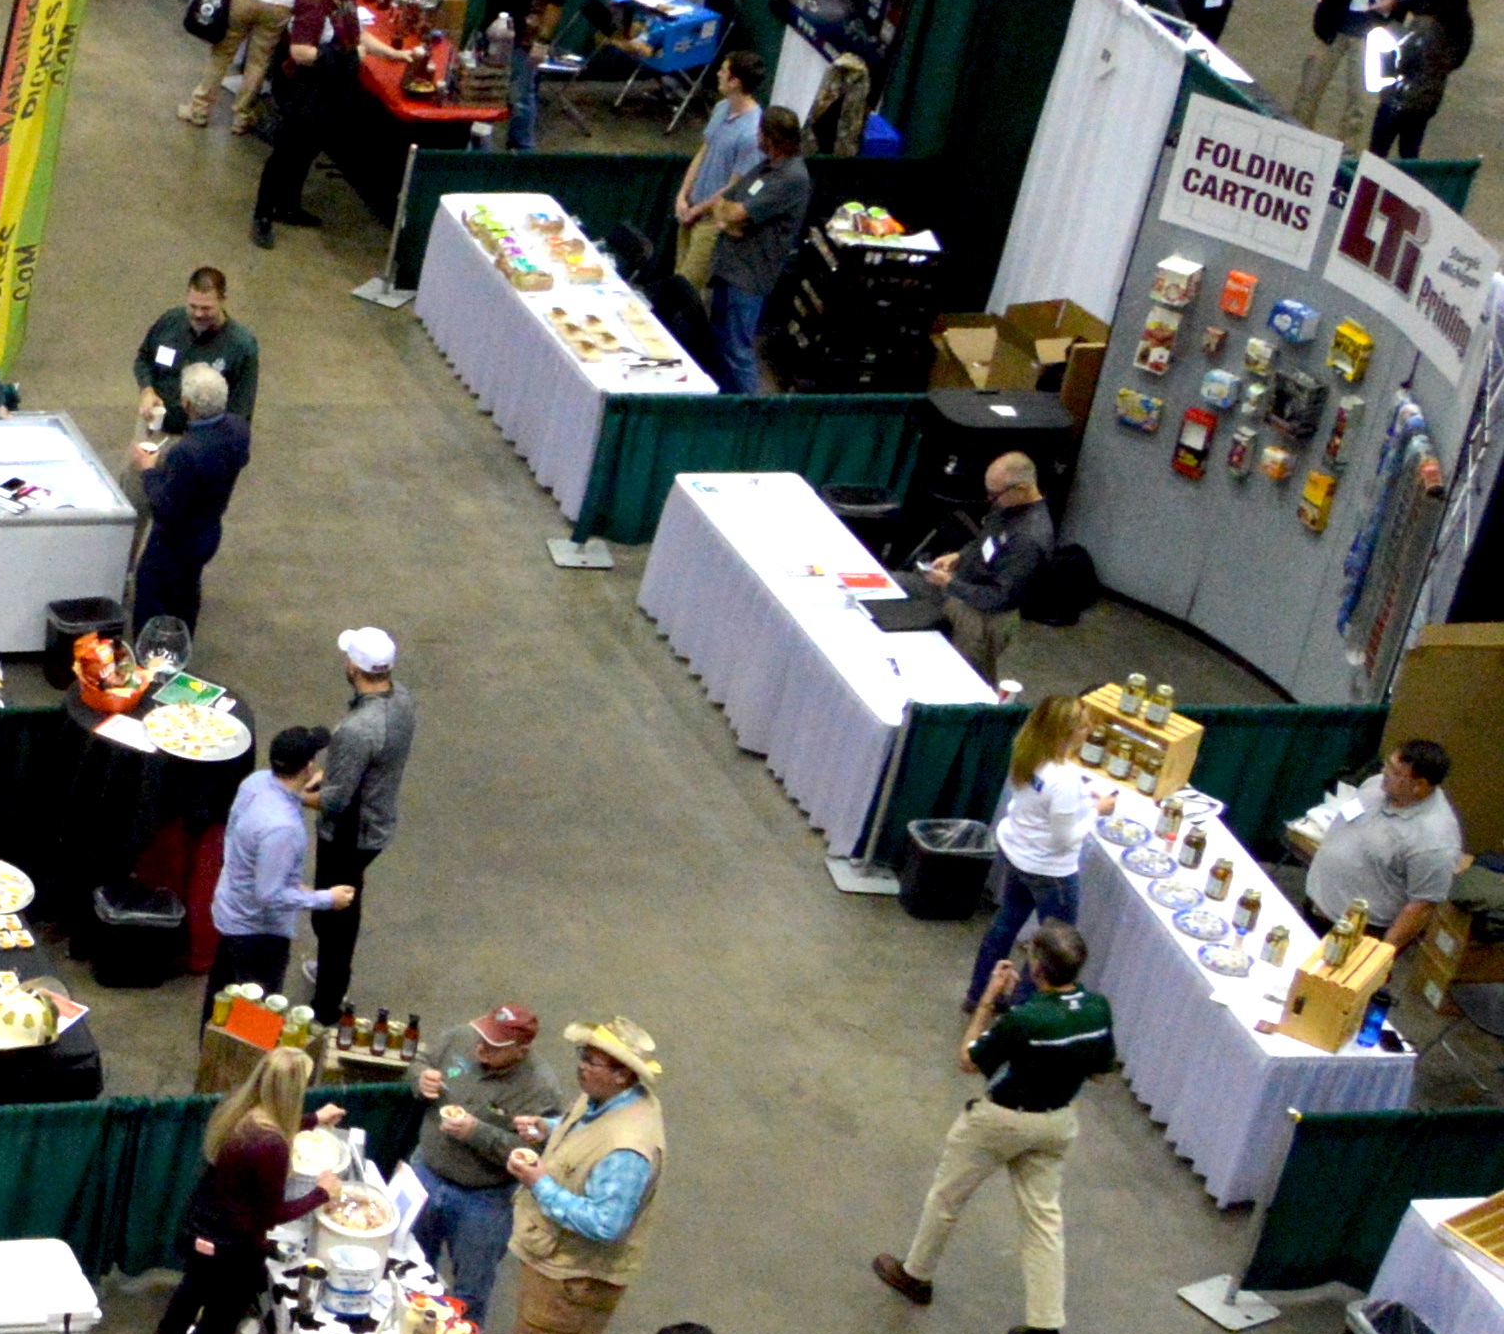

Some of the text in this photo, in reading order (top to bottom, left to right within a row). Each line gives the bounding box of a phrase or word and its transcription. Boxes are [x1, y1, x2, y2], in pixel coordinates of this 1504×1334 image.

[20, 0, 64, 121] PICKLES
[1181, 166, 1312, 231] CARTONS
[1195, 136, 1315, 198] FOLDING
[1415, 274, 1473, 359] Printing
